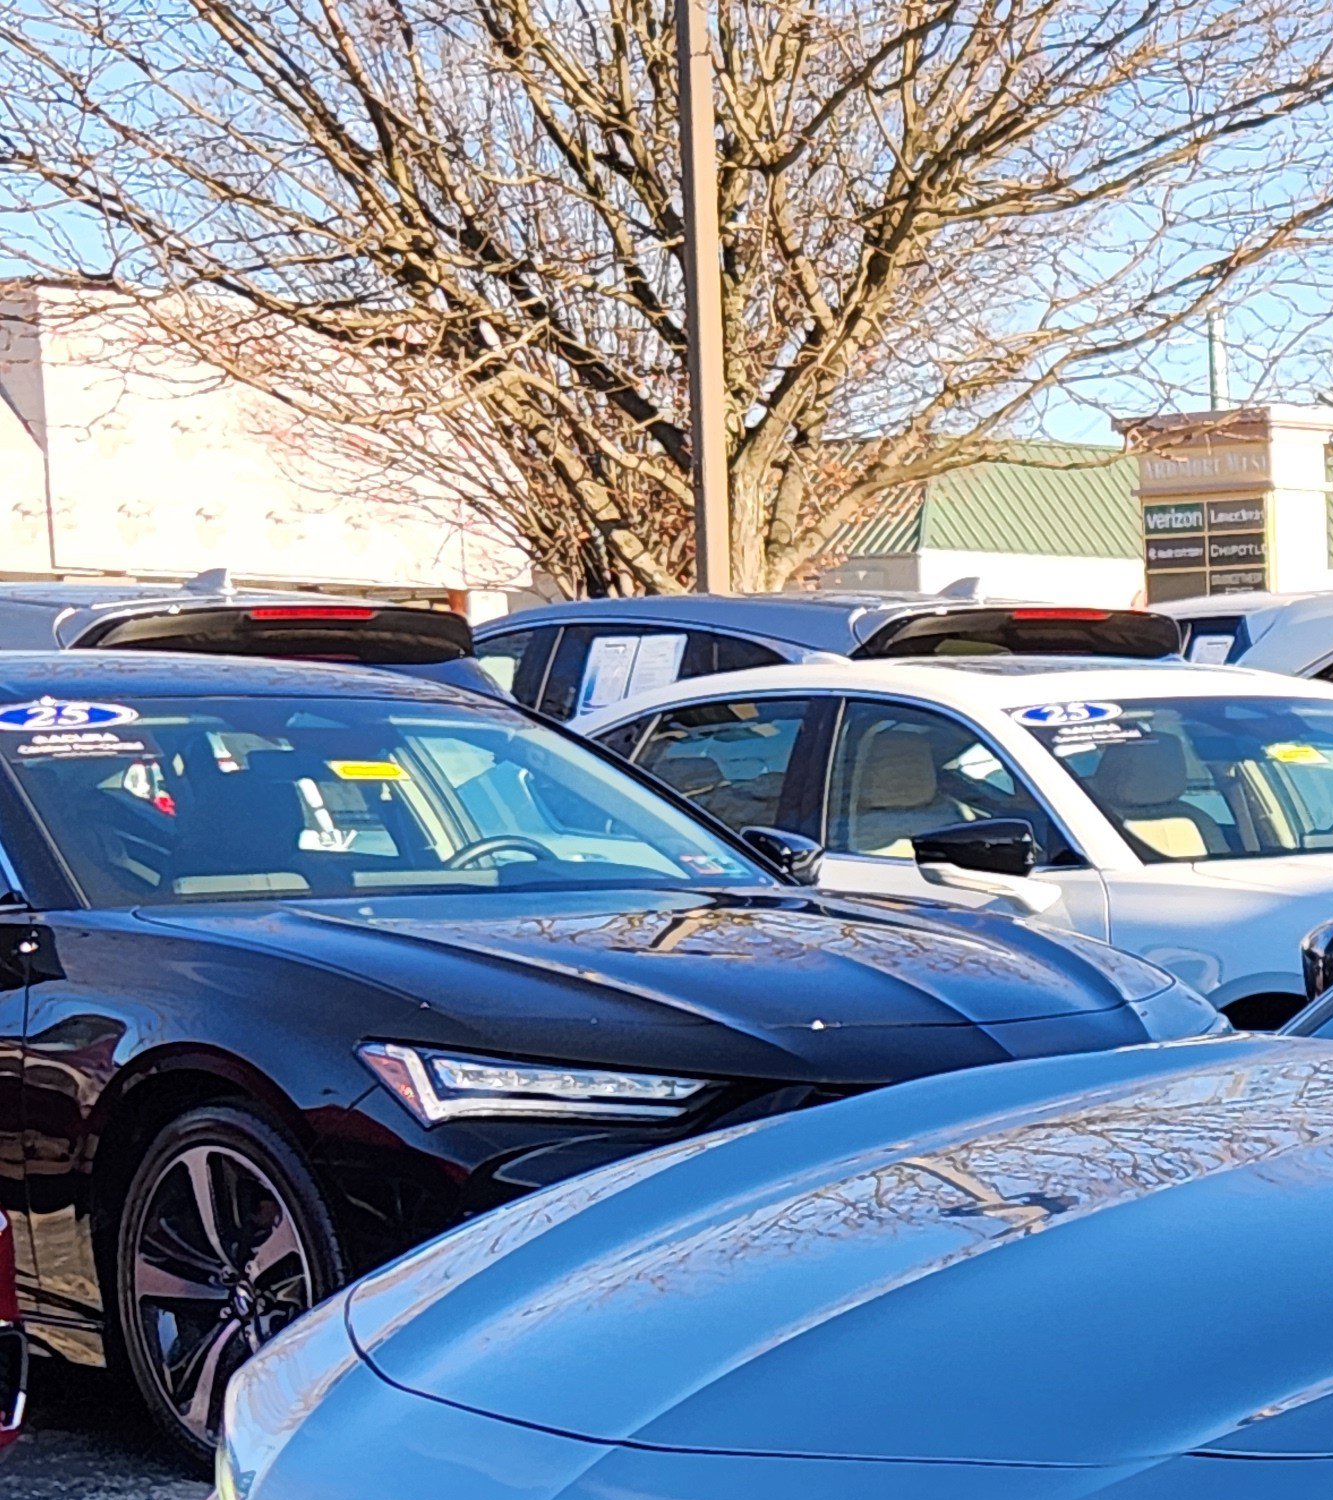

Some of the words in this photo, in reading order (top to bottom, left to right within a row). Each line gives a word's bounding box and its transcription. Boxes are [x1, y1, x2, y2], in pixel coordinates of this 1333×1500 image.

[1146, 508, 1203, 529] verizon
[23, 704, 91, 728] 25
[1040, 702, 1090, 723] 25
